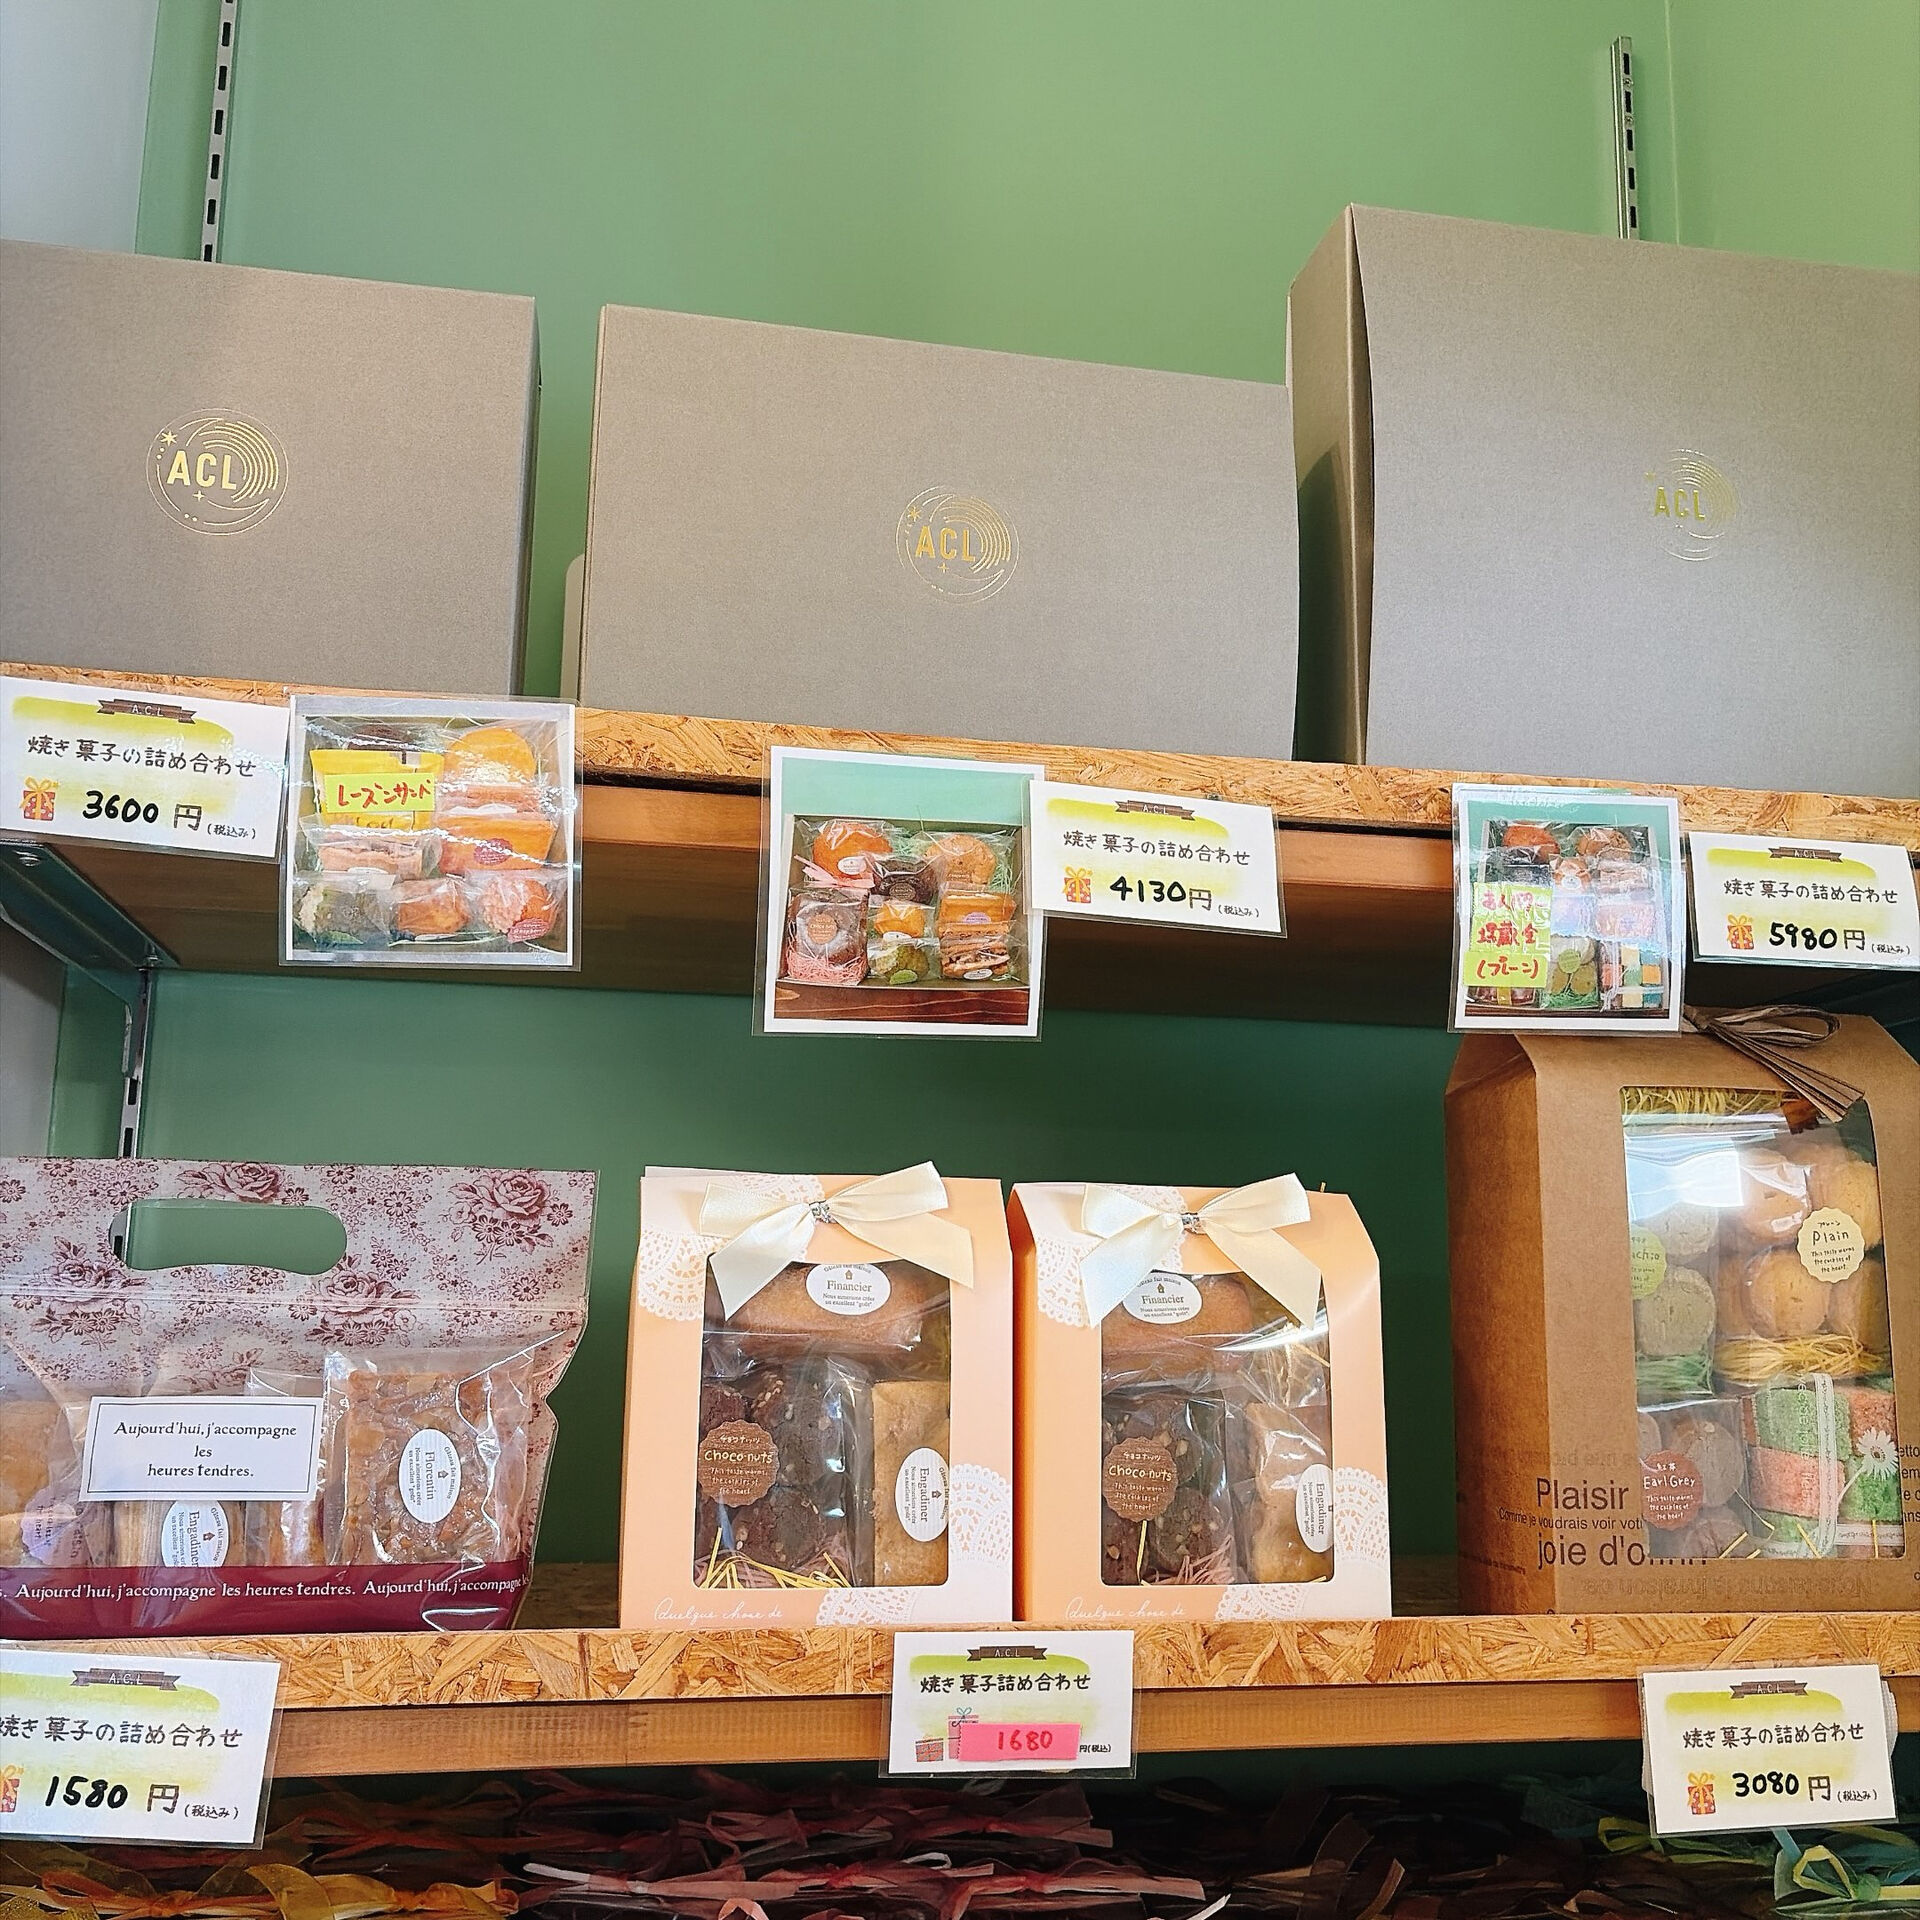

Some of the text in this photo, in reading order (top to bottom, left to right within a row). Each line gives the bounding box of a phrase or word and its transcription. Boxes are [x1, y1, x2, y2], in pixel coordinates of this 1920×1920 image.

[167, 450, 237, 490] ACL
[1654, 486, 1706, 521] ACL
[915, 525, 976, 562] ACL
[27, 734, 256, 777] 焼き菓子の詰め合わせ
[338, 779, 431, 809] レーズンサンド
[83, 790, 159, 823] 3600
[174, 803, 202, 831] 円
[1063, 830, 1250, 866] 焼き菓子の詰め合わせ
[1110, 876, 1186, 903] 4130
[1189, 888, 1212, 911] 円
[1723, 878, 1898, 903] 焼き菓子の詰め合わせ
[1769, 922, 1837, 950] 5980
[1844, 929, 1865, 950] 円
[1477, 955, 1539, 979] (プレーン)
[826, 1280, 873, 1293] Financier
[1141, 1295, 1184, 1305] Financier
[194, 1445, 213, 1458] les
[147, 1464, 254, 1478] heures tendres.
[425, 1451, 437, 1500] Florentin
[1643, 1475, 1696, 1489] Earl Grey
[918, 1467, 930, 1523] Engadiner
[1315, 1483, 1327, 1535] Engadiner
[1536, 1477, 1630, 1510] Plaisir
[1499, 1506, 1527, 1524] Comme
[1528, 1516, 1536, 1527] je
[1538, 1516, 1588, 1530] voudrais
[1592, 1516, 1617, 1530] voir
[187, 1511, 201, 1567] Engadiner
[1538, 1533, 1587, 1570] joie
[221, 1583, 241, 1597] les
[245, 1582, 294, 1596] heures
[297, 1582, 356, 1596] tendres.
[920, 1672, 1091, 1694] 焼き菓子詰め合わせ
[997, 1729, 1053, 1751] 1680
[1683, 1722, 1864, 1749] 焼き菓子の詰め合わせ
[45, 1775, 129, 1809] 1580
[147, 1783, 179, 1814] 円
[1732, 1770, 1799, 1798] 3080
[1807, 1775, 1831, 1801] 円
